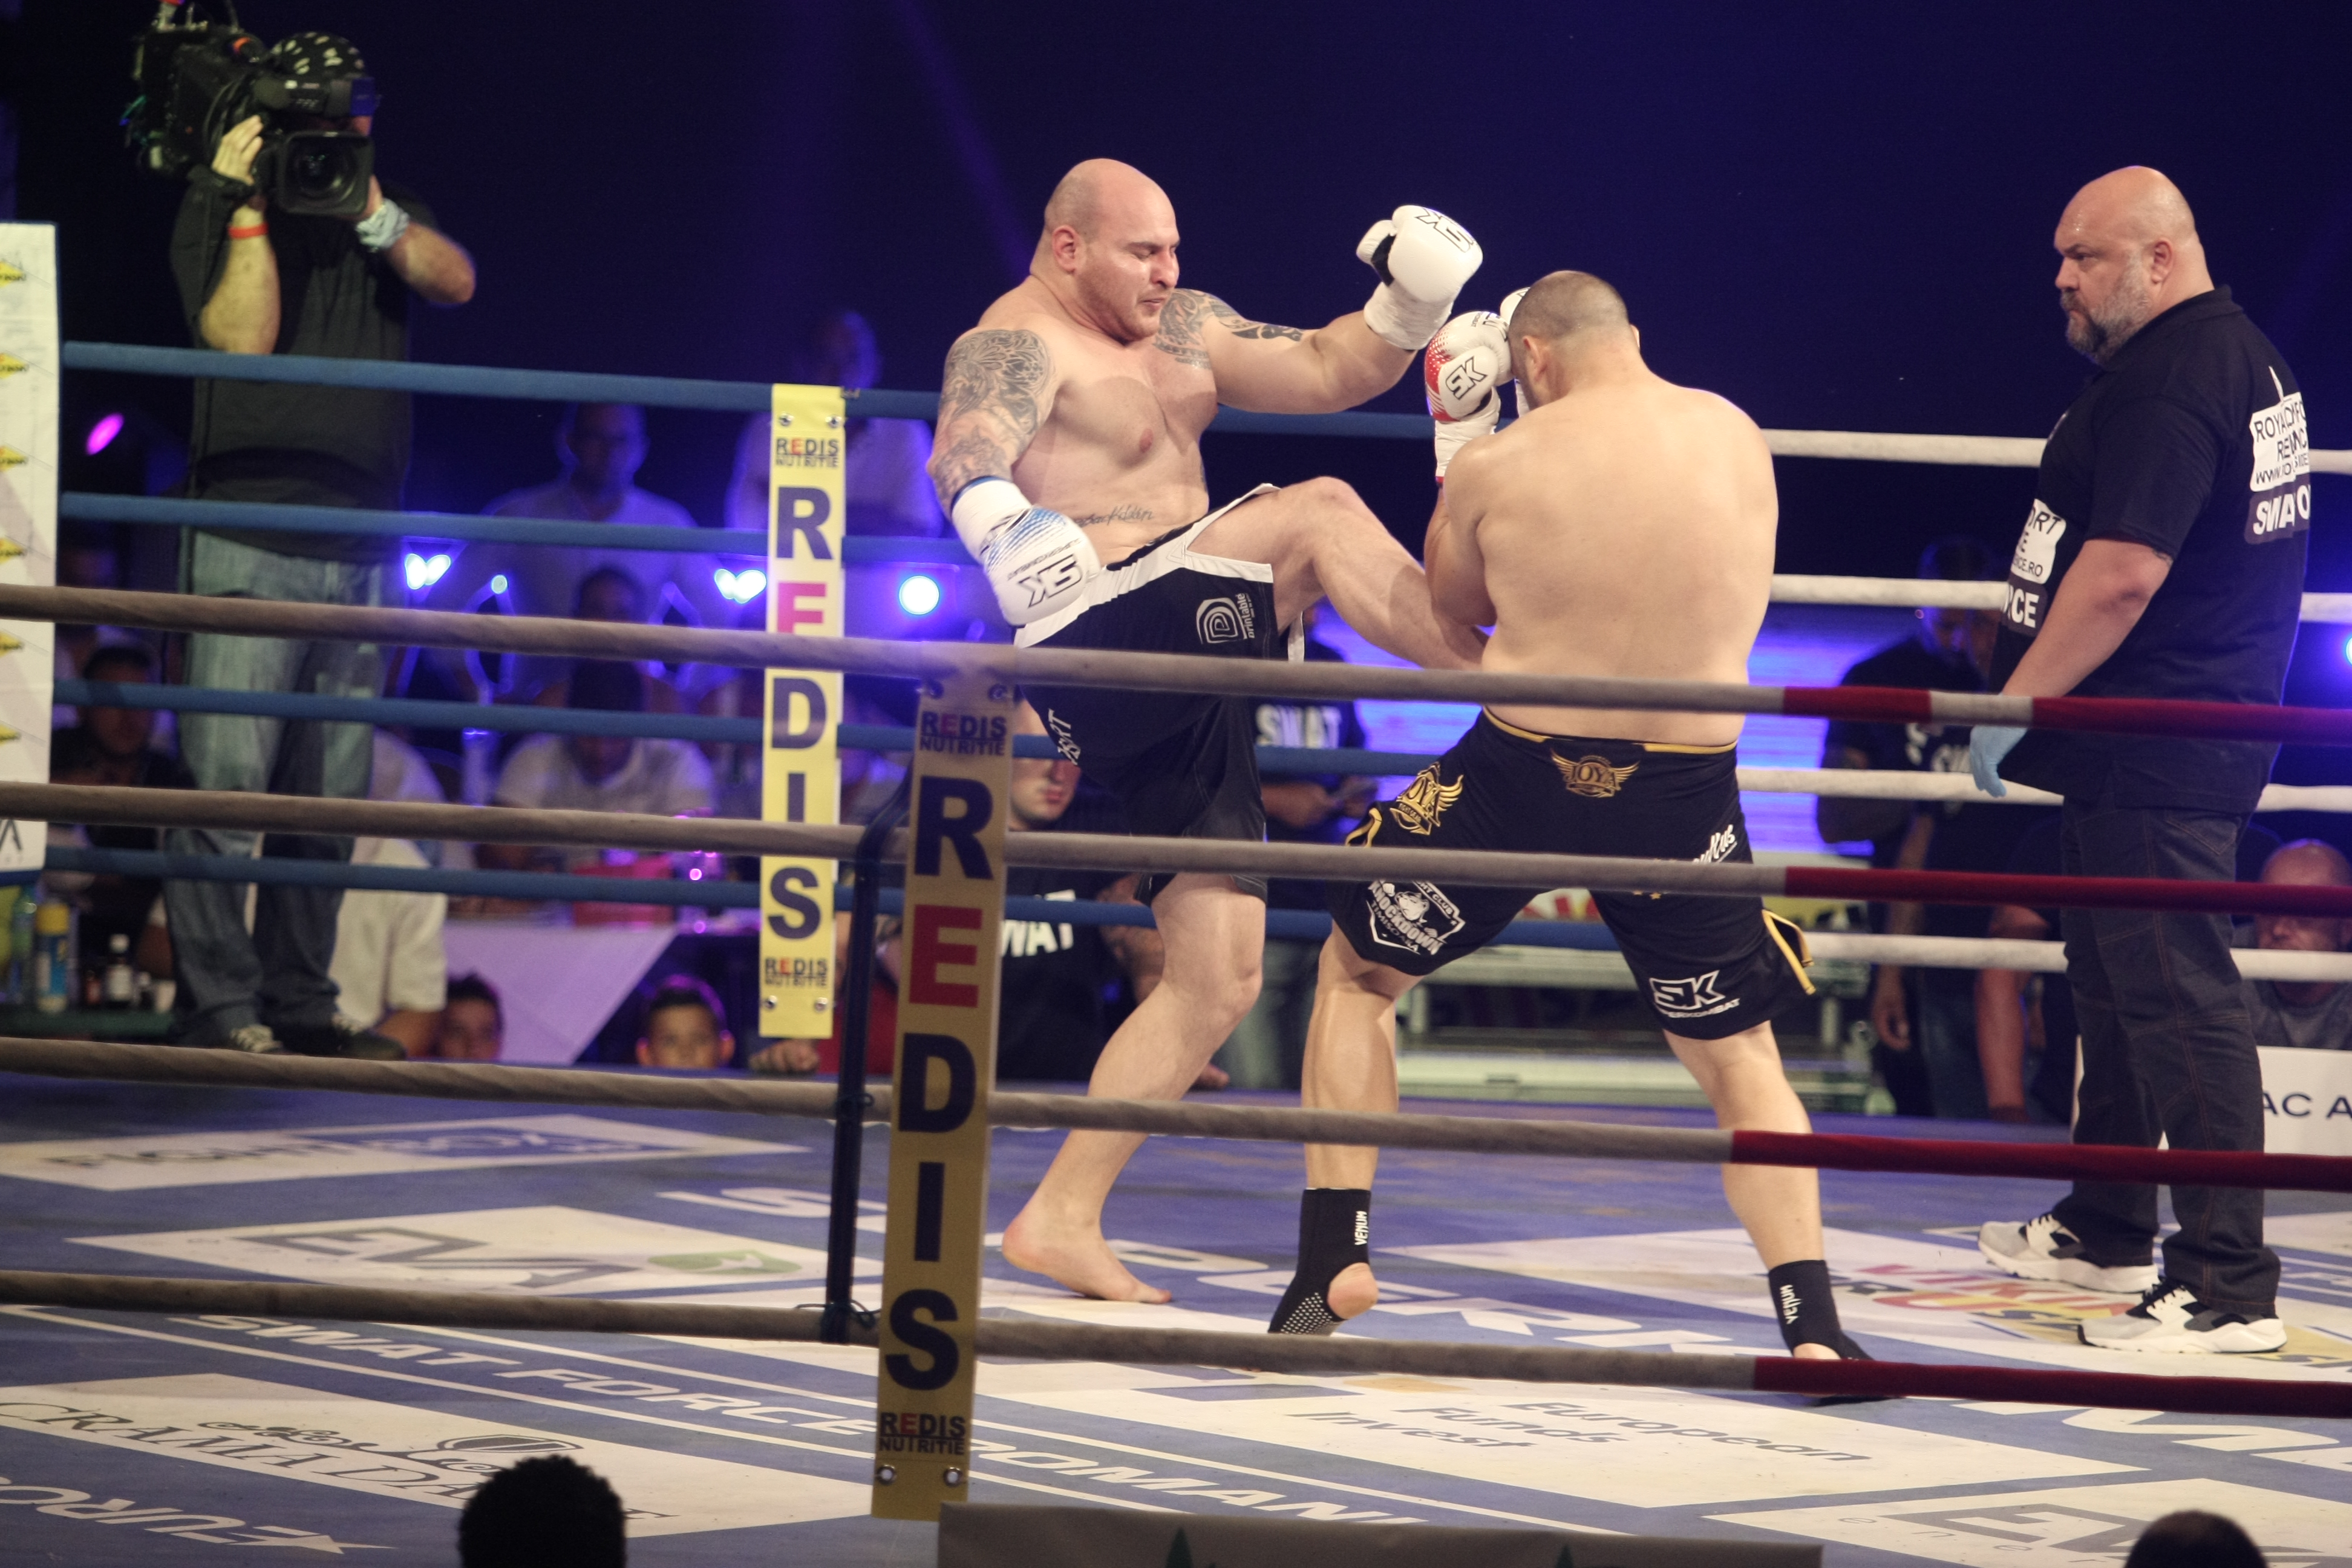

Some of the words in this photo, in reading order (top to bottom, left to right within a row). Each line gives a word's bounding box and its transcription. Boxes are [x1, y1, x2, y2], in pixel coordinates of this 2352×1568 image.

[776, 437, 839, 457] REDIS
[776, 454, 838, 468] NUTRITIE
[1235, 593, 1255, 639] printable
[768, 486, 834, 939] REDIS
[921, 711, 1007, 739] REDIS
[920, 736, 1005, 756] NUTRITIE
[764, 958, 828, 978] REDIS
[885, 776, 994, 1392] REDIS
[1354, 1210, 1369, 1246] VENUM
[1780, 1284, 1803, 1324] VENUM
[879, 1411, 967, 1440] REDIS
[1285, 1411, 1538, 1448] Invest
[1391, 1406, 1630, 1443] Funds
[1503, 1401, 1873, 1462] European
[878, 1436, 965, 1455] NUTRITIE
